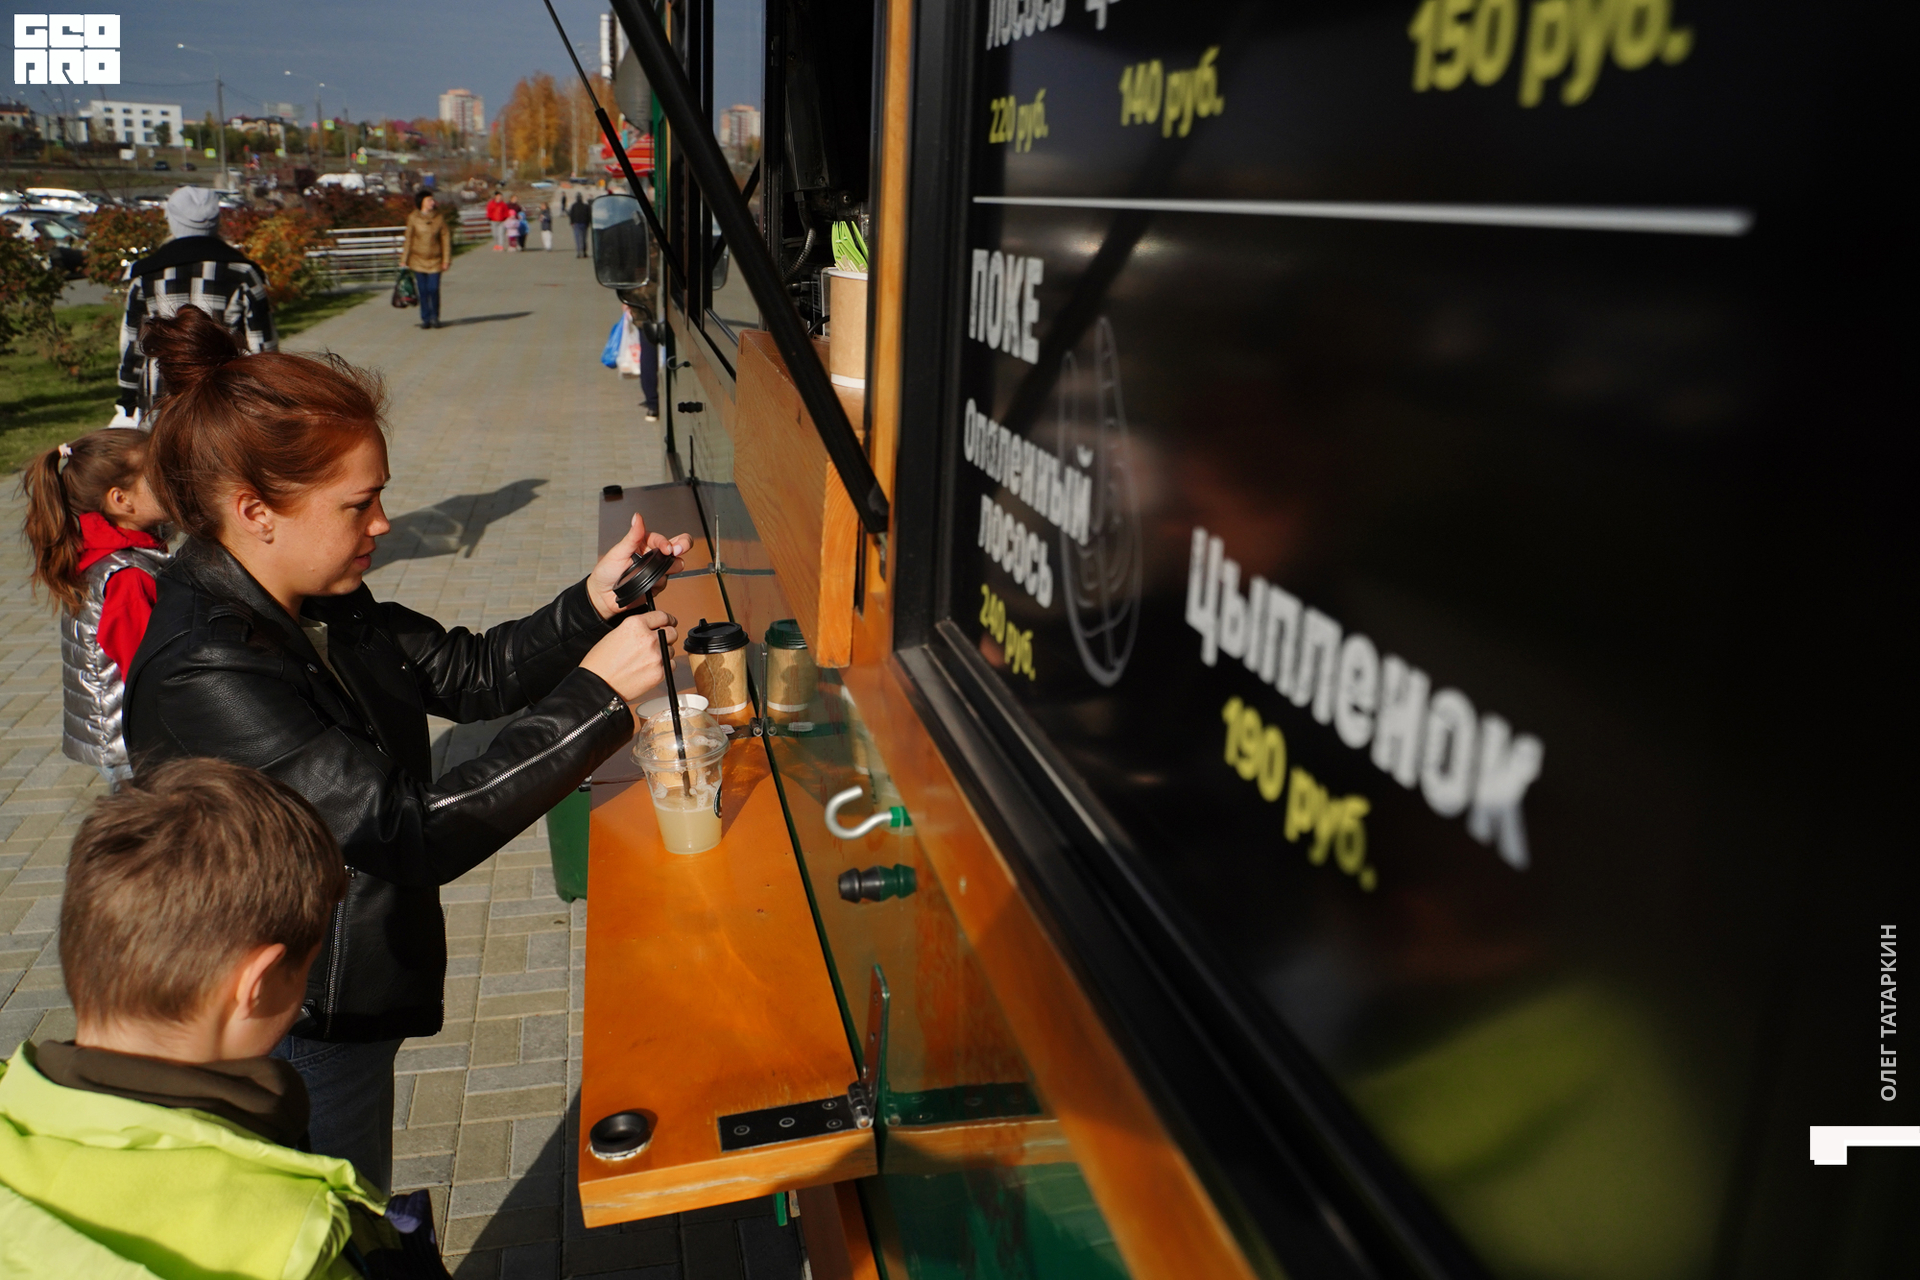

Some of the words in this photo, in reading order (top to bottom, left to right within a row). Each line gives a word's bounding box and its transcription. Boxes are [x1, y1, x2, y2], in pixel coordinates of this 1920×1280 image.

[1119, 59, 1163, 126] 140
[1162, 45, 1224, 138] руб.
[1408, 0, 1519, 92] 150
[989, 95, 1016, 143] 220
[1015, 88, 1048, 153] руб.
[969, 249, 1043, 363] ПОКЕ
[964, 398, 1093, 545] Опаленный
[980, 584, 1006, 643] 240
[1004, 621, 1036, 681] руб.
[1186, 526, 1544, 871] Цыпленок
[1222, 696, 1287, 802] 190
[1284, 767, 1378, 892] руб.
